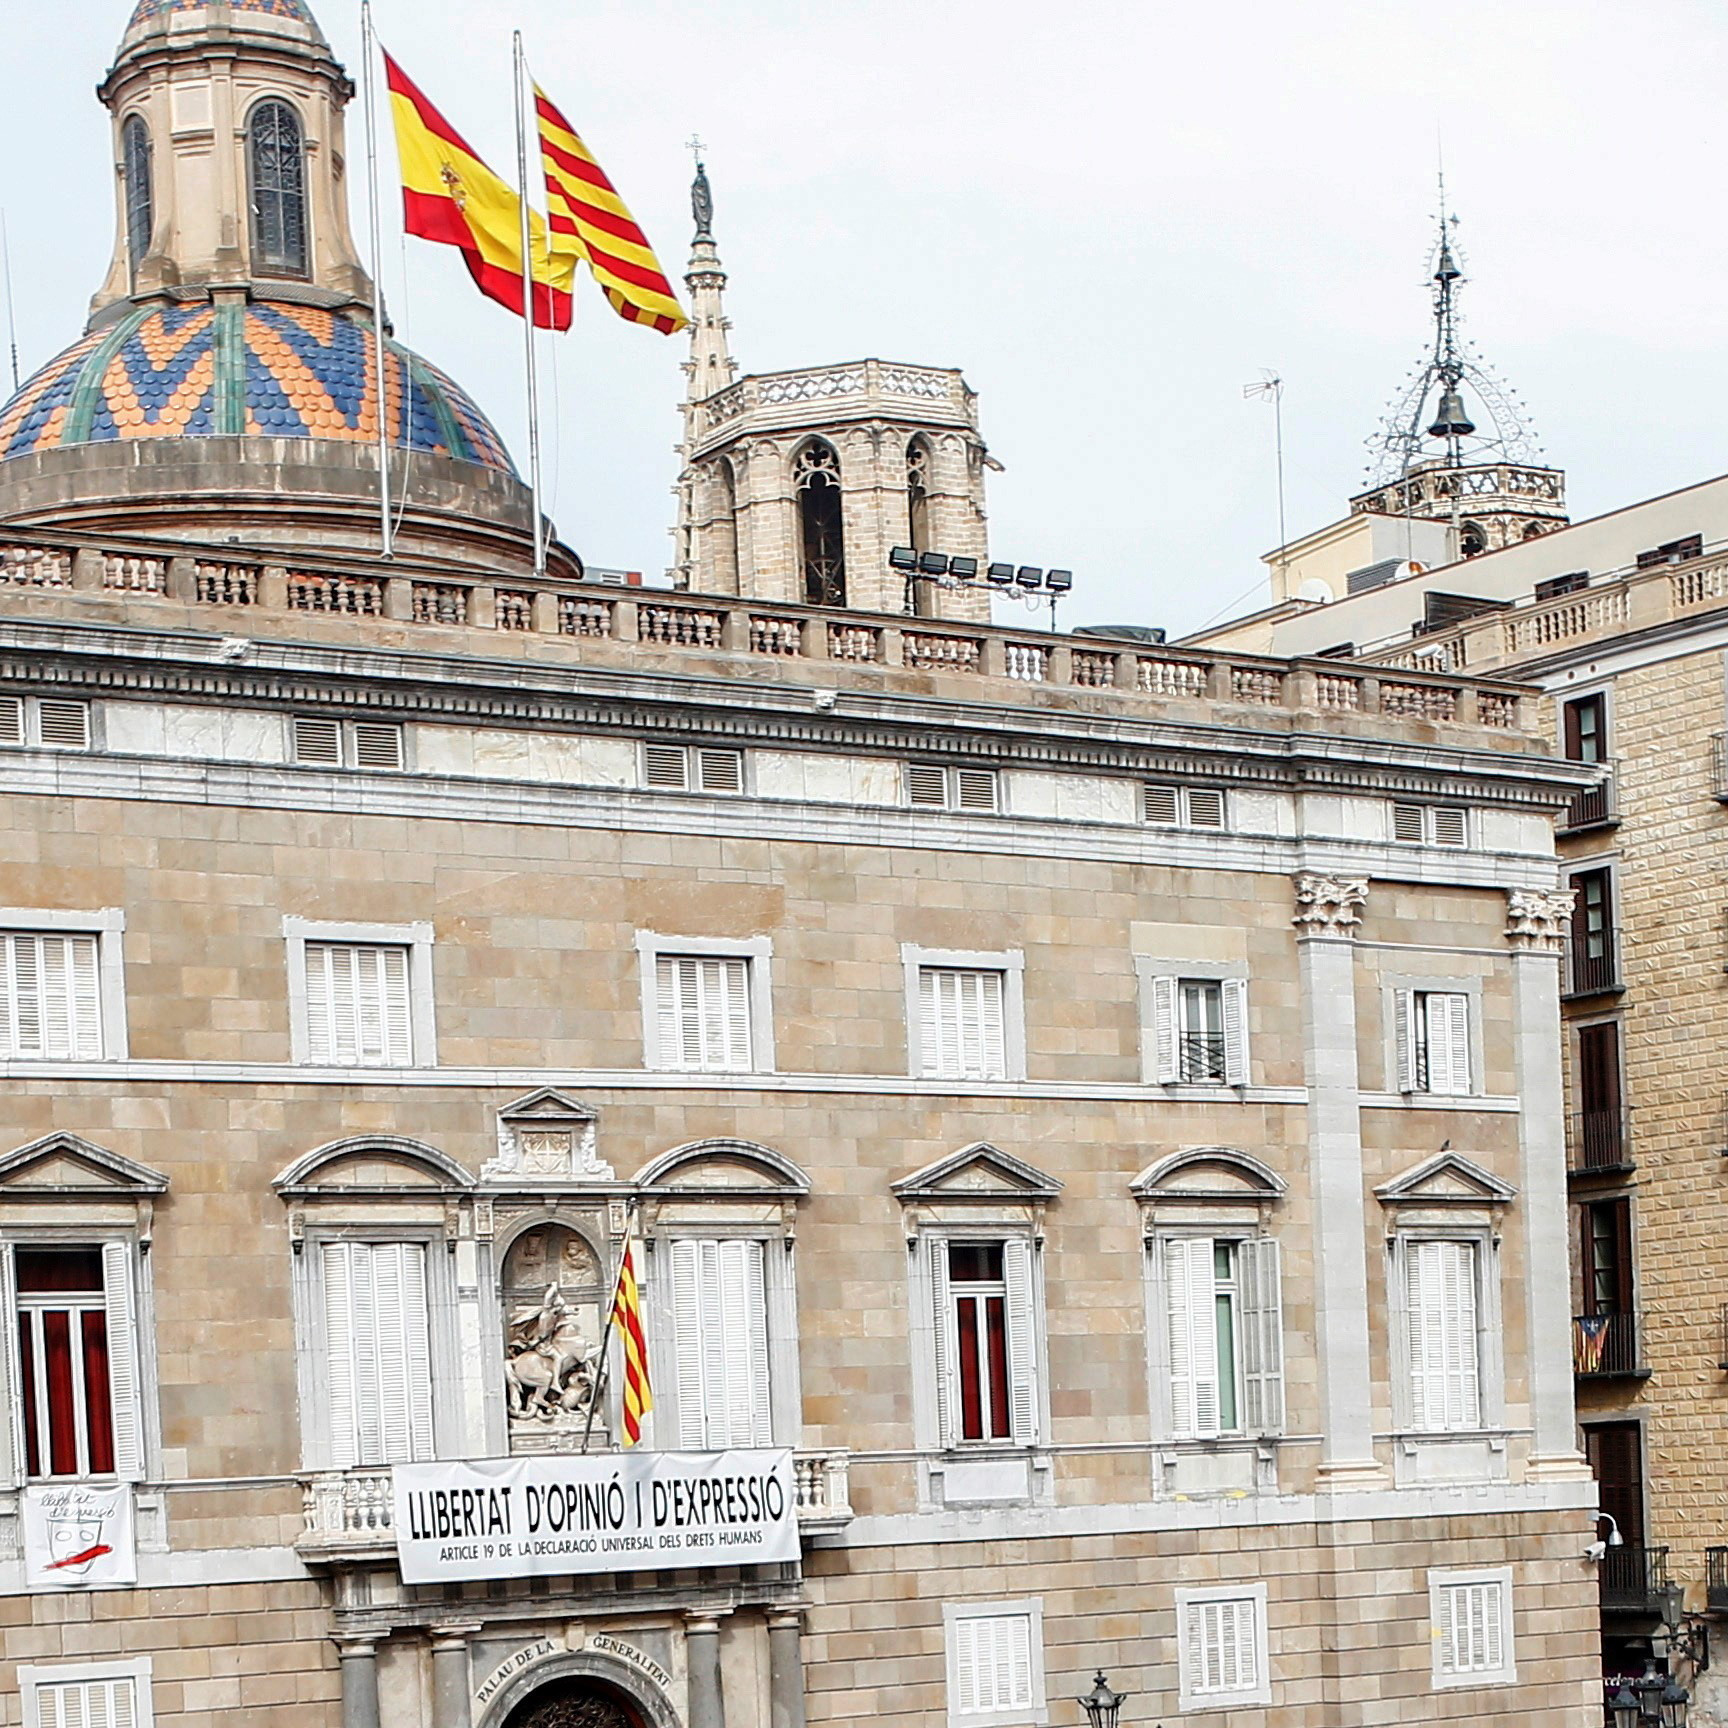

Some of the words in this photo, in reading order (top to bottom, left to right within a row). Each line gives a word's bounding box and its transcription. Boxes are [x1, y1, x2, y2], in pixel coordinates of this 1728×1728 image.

[408, 1486, 512, 1540] LLIBERTAT
[525, 1471, 625, 1533] D'OPINIÓ
[635, 1481, 642, 1528] I
[653, 1465, 784, 1527] D'EXPRESSIÓ
[439, 1545, 479, 1561] ARTICLE
[483, 1544, 494, 1558] 19
[499, 1543, 513, 1557] DE
[518, 1542, 533, 1556] LA
[534, 1534, 598, 1554] DECLARACIÓ
[602, 1536, 654, 1551] UNIVERSAL
[659, 1534, 682, 1548] DELS
[686, 1532, 715, 1547] DRETS
[718, 1530, 763, 1545] HUMANS
[478, 1663, 514, 1703] PALAU
[515, 1649, 535, 1666] DE
[536, 1641, 555, 1655] LA
[593, 1636, 672, 1687] GENERALITAT
